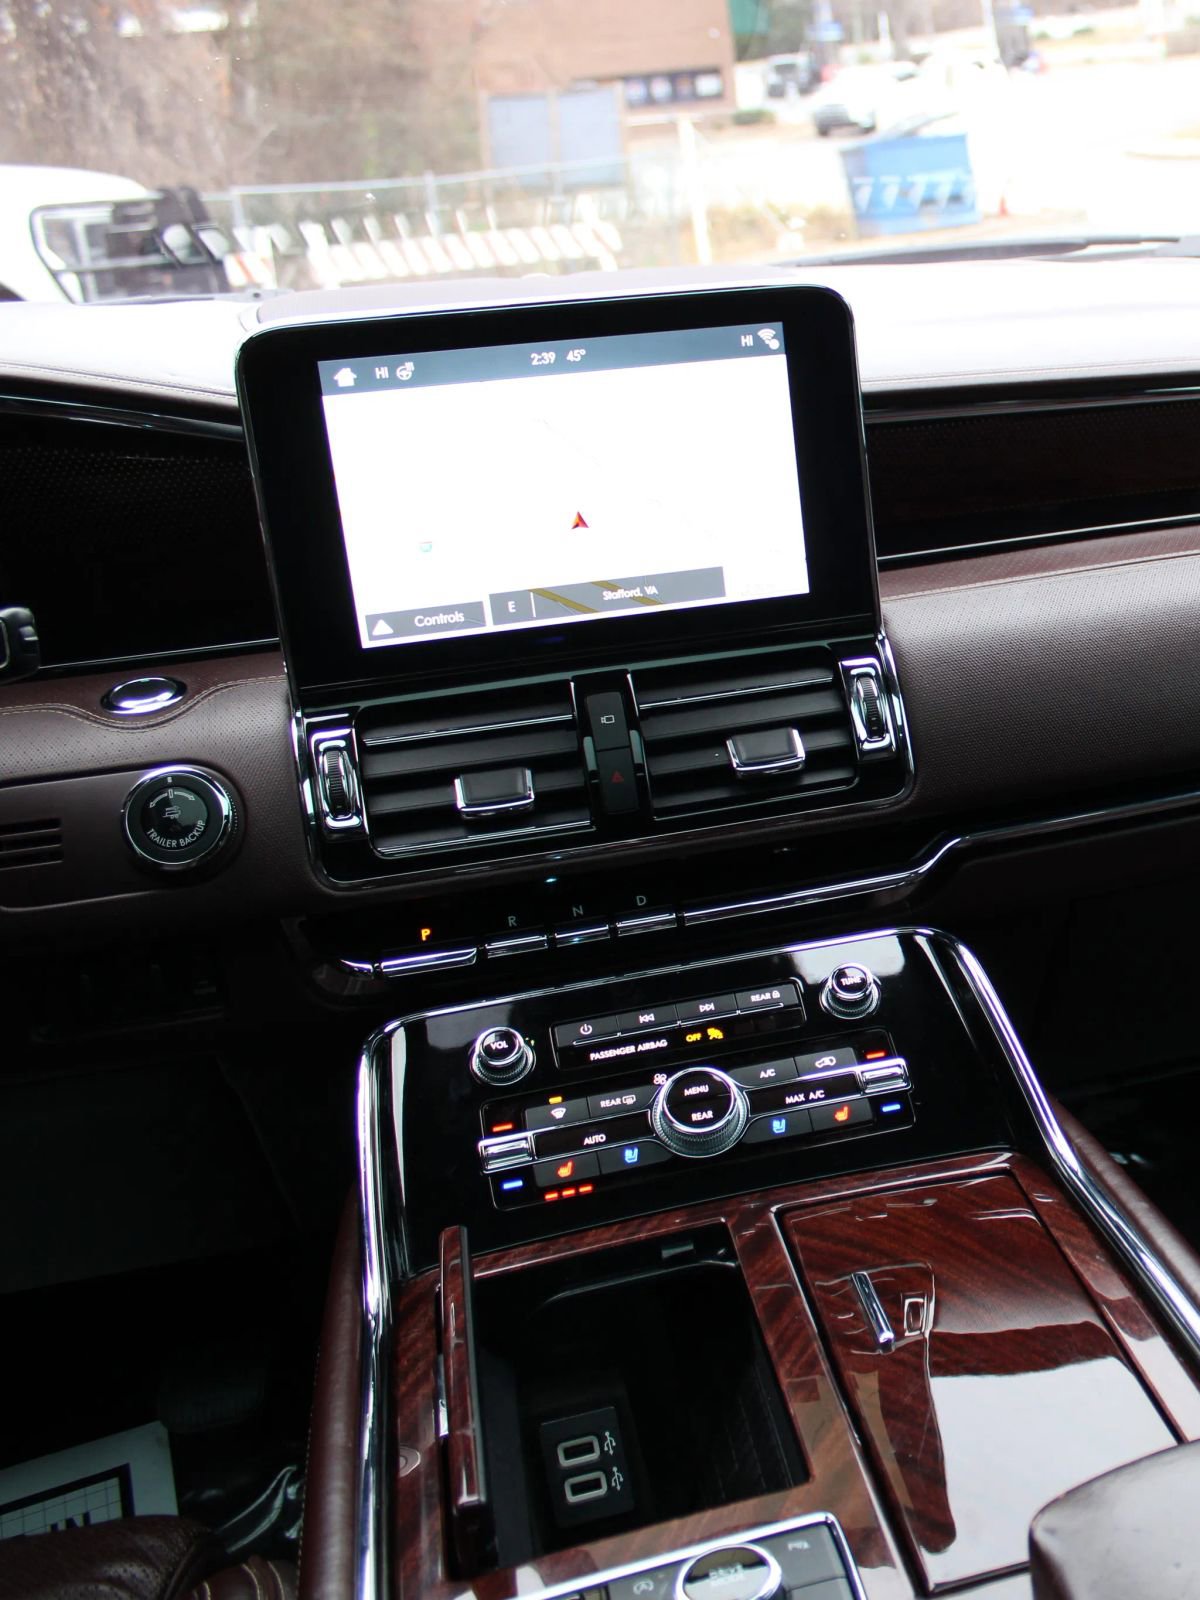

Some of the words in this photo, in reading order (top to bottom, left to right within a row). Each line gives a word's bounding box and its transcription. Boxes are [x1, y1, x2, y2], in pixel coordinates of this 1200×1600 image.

[741, 334, 753, 347] HI
[530, 351, 556, 366] 2:39
[375, 366, 389, 379] HI
[602, 586, 643, 601] Stafford,
[644, 585, 658, 596] VA
[508, 600, 516, 613] E
[414, 610, 465, 628] Controls
[146, 828, 177, 848] TRAILER
[179, 819, 206, 847] BACKUP
[636, 895, 647, 906] D
[572, 905, 584, 917] N
[507, 915, 517, 927] R
[420, 928, 431, 942] P
[839, 976, 862, 987] TUNE
[750, 992, 772, 1002] REAR
[490, 1040, 508, 1051] VOL
[590, 1045, 635, 1061] PASSENGER
[637, 1039, 668, 1053] AIRBAG
[685, 1032, 702, 1043] OFF
[759, 1068, 776, 1079] A/C
[684, 1084, 709, 1097] MENU
[785, 1094, 805, 1105] MAX
[808, 1089, 825, 1100] A/C
[600, 1097, 622, 1108] REAR
[691, 1109, 713, 1122] REAR
[583, 1133, 606, 1146] AUTO
